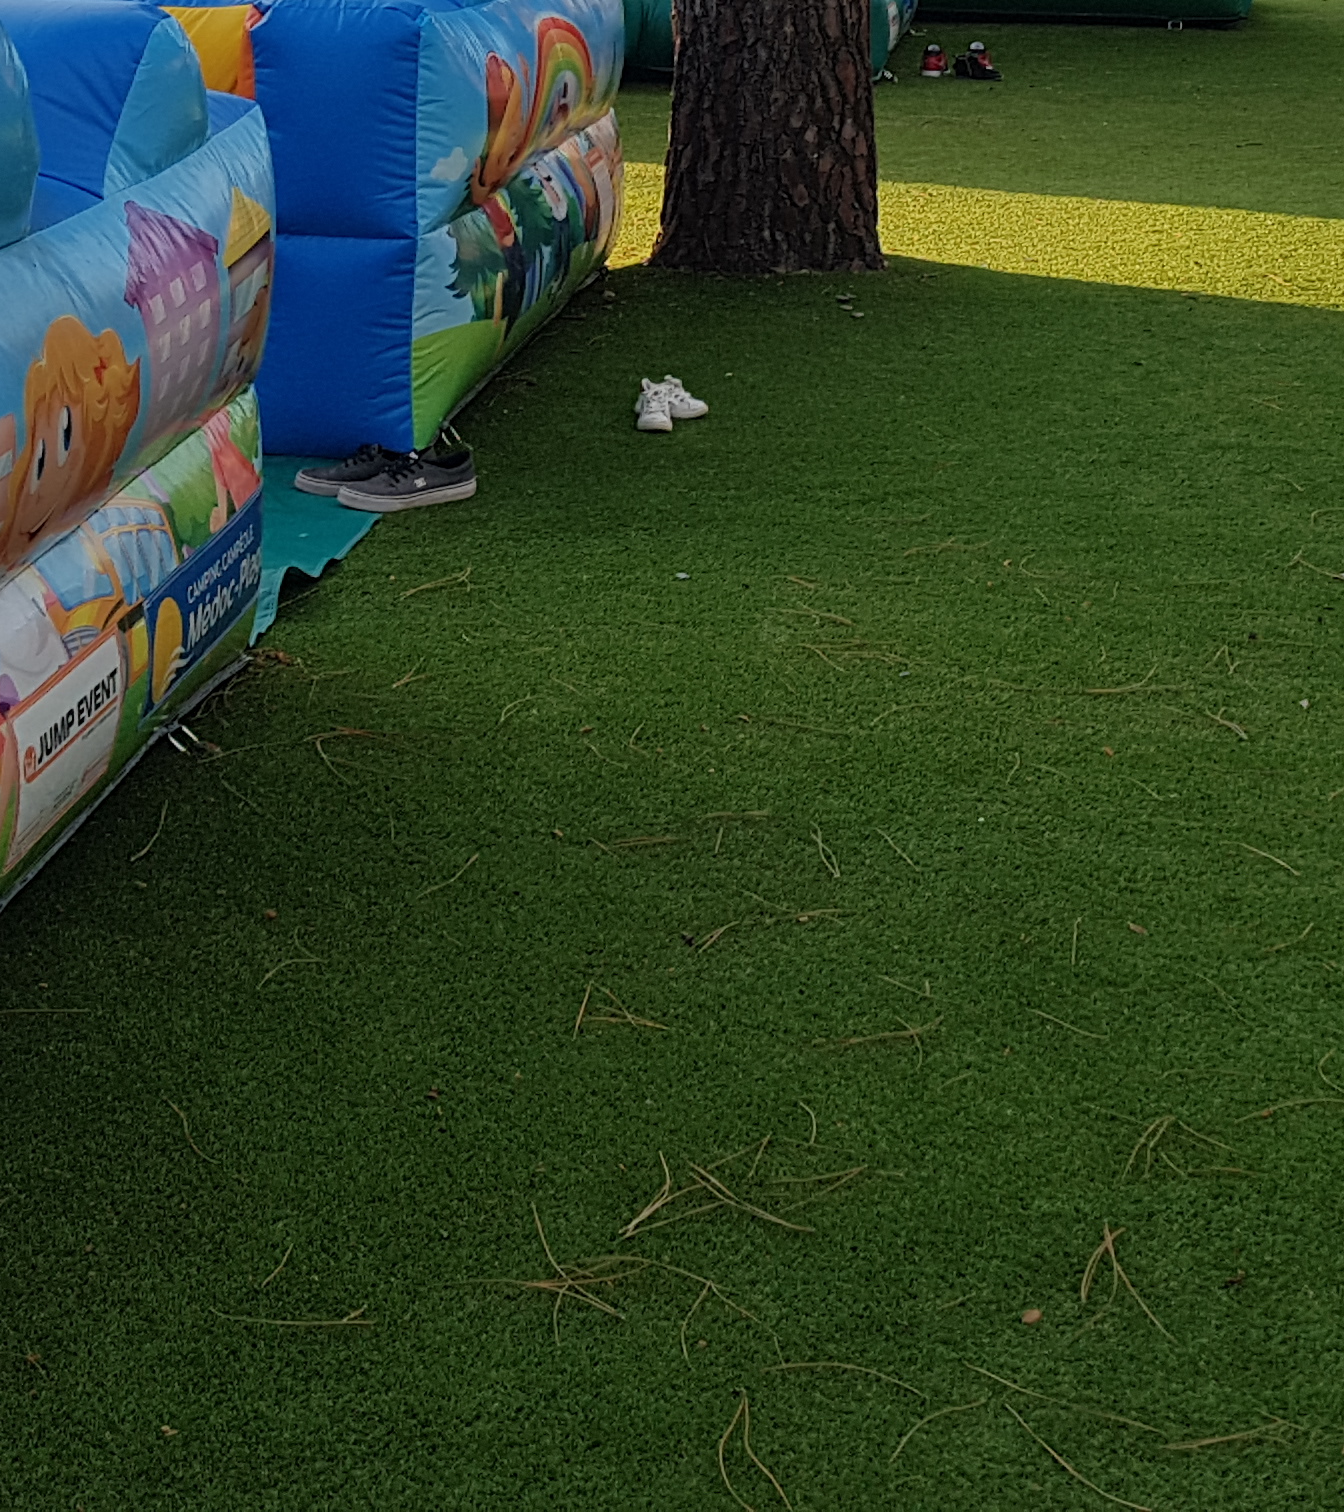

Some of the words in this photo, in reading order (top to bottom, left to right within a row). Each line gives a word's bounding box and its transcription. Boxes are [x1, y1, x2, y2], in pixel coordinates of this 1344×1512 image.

[187, 558, 223, 604] CAMPING
[37, 708, 75, 765] JUMP
[77, 666, 118, 727] EVENT
